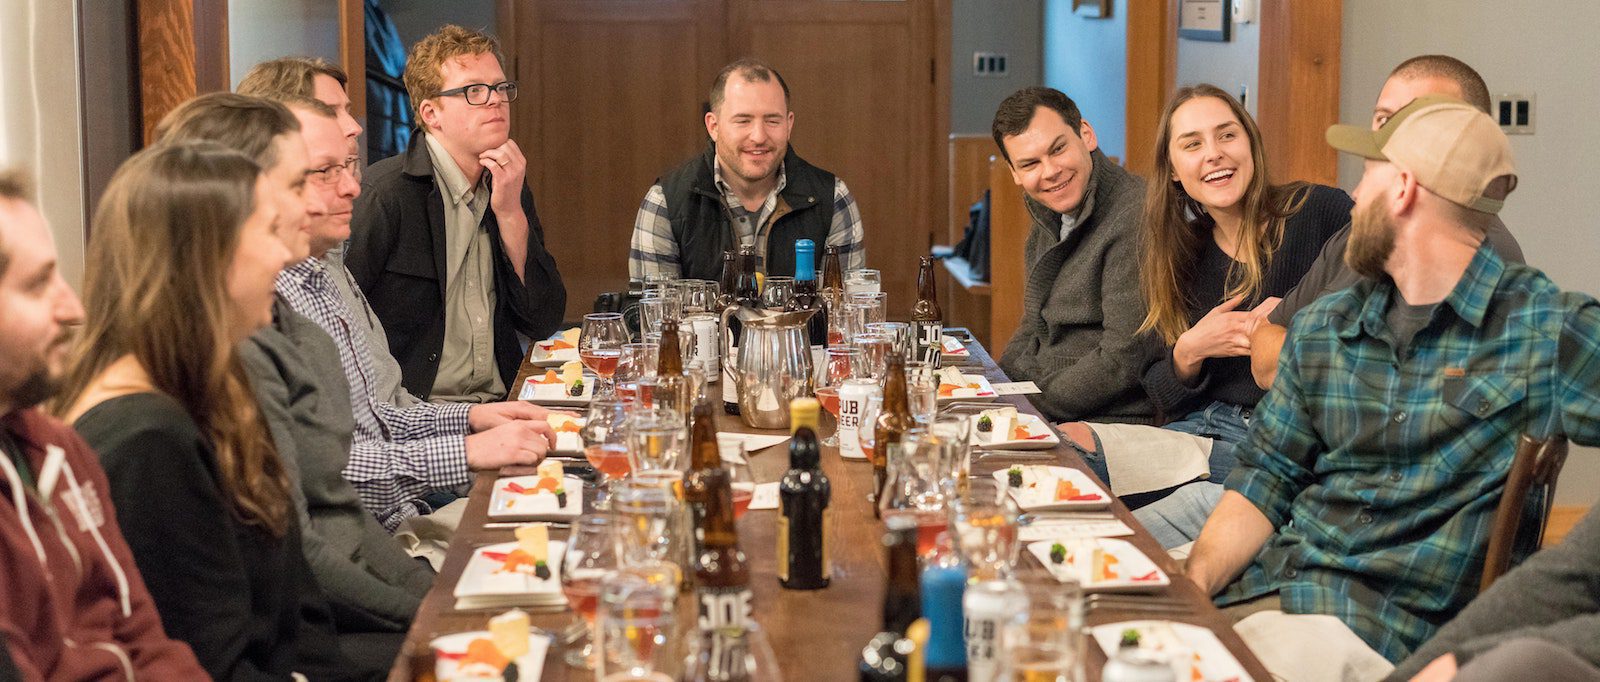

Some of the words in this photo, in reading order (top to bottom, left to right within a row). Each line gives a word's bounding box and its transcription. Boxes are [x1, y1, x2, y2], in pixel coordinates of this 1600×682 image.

[919, 324, 943, 345] JO
[839, 400, 858, 414] UB
[841, 416, 859, 427] EER
[698, 591, 755, 630] JOE
[965, 615, 995, 640] UB
